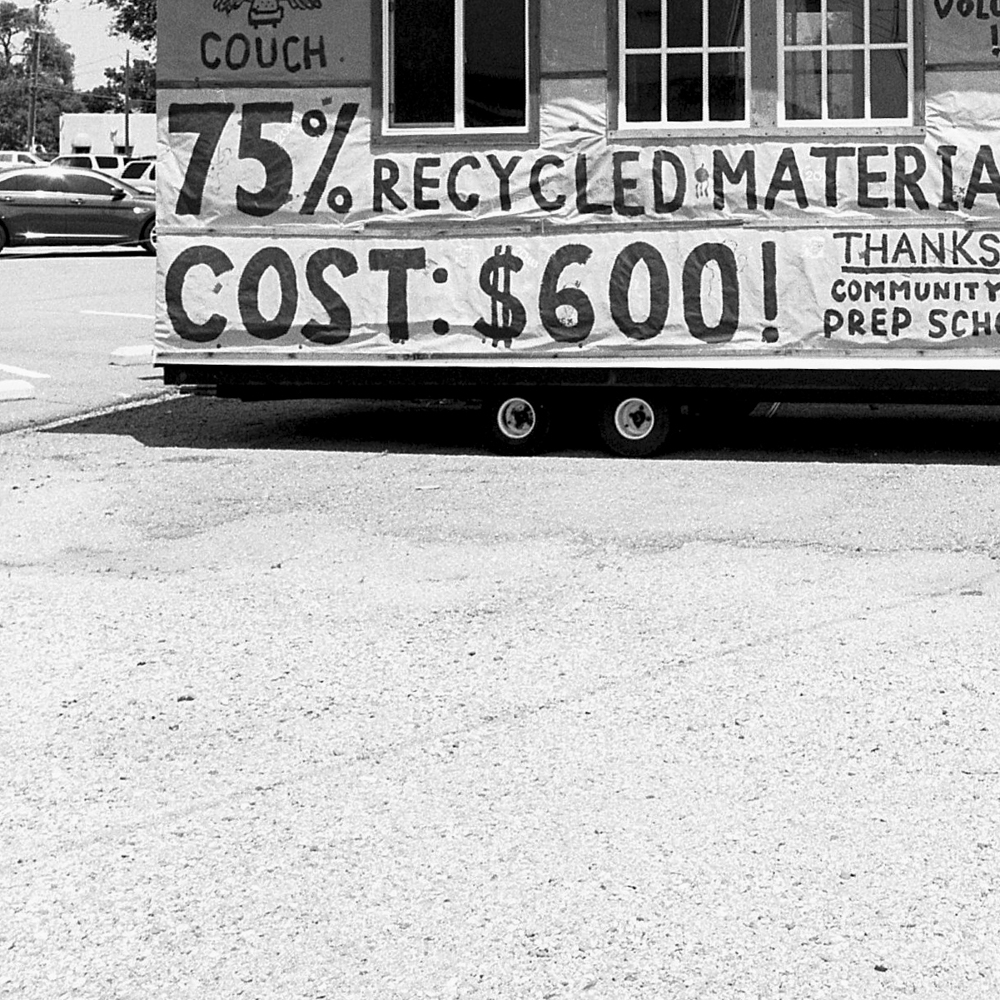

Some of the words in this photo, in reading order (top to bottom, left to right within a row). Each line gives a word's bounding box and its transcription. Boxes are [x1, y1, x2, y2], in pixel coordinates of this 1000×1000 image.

[200, 31, 328, 72] COUCH
[168, 102, 359, 217] 75%
[373, 148, 687, 217] RECYCLED
[165, 244, 450, 345] COST:
[474, 241, 780, 348] $600!
[823, 307, 912, 338] PREP
